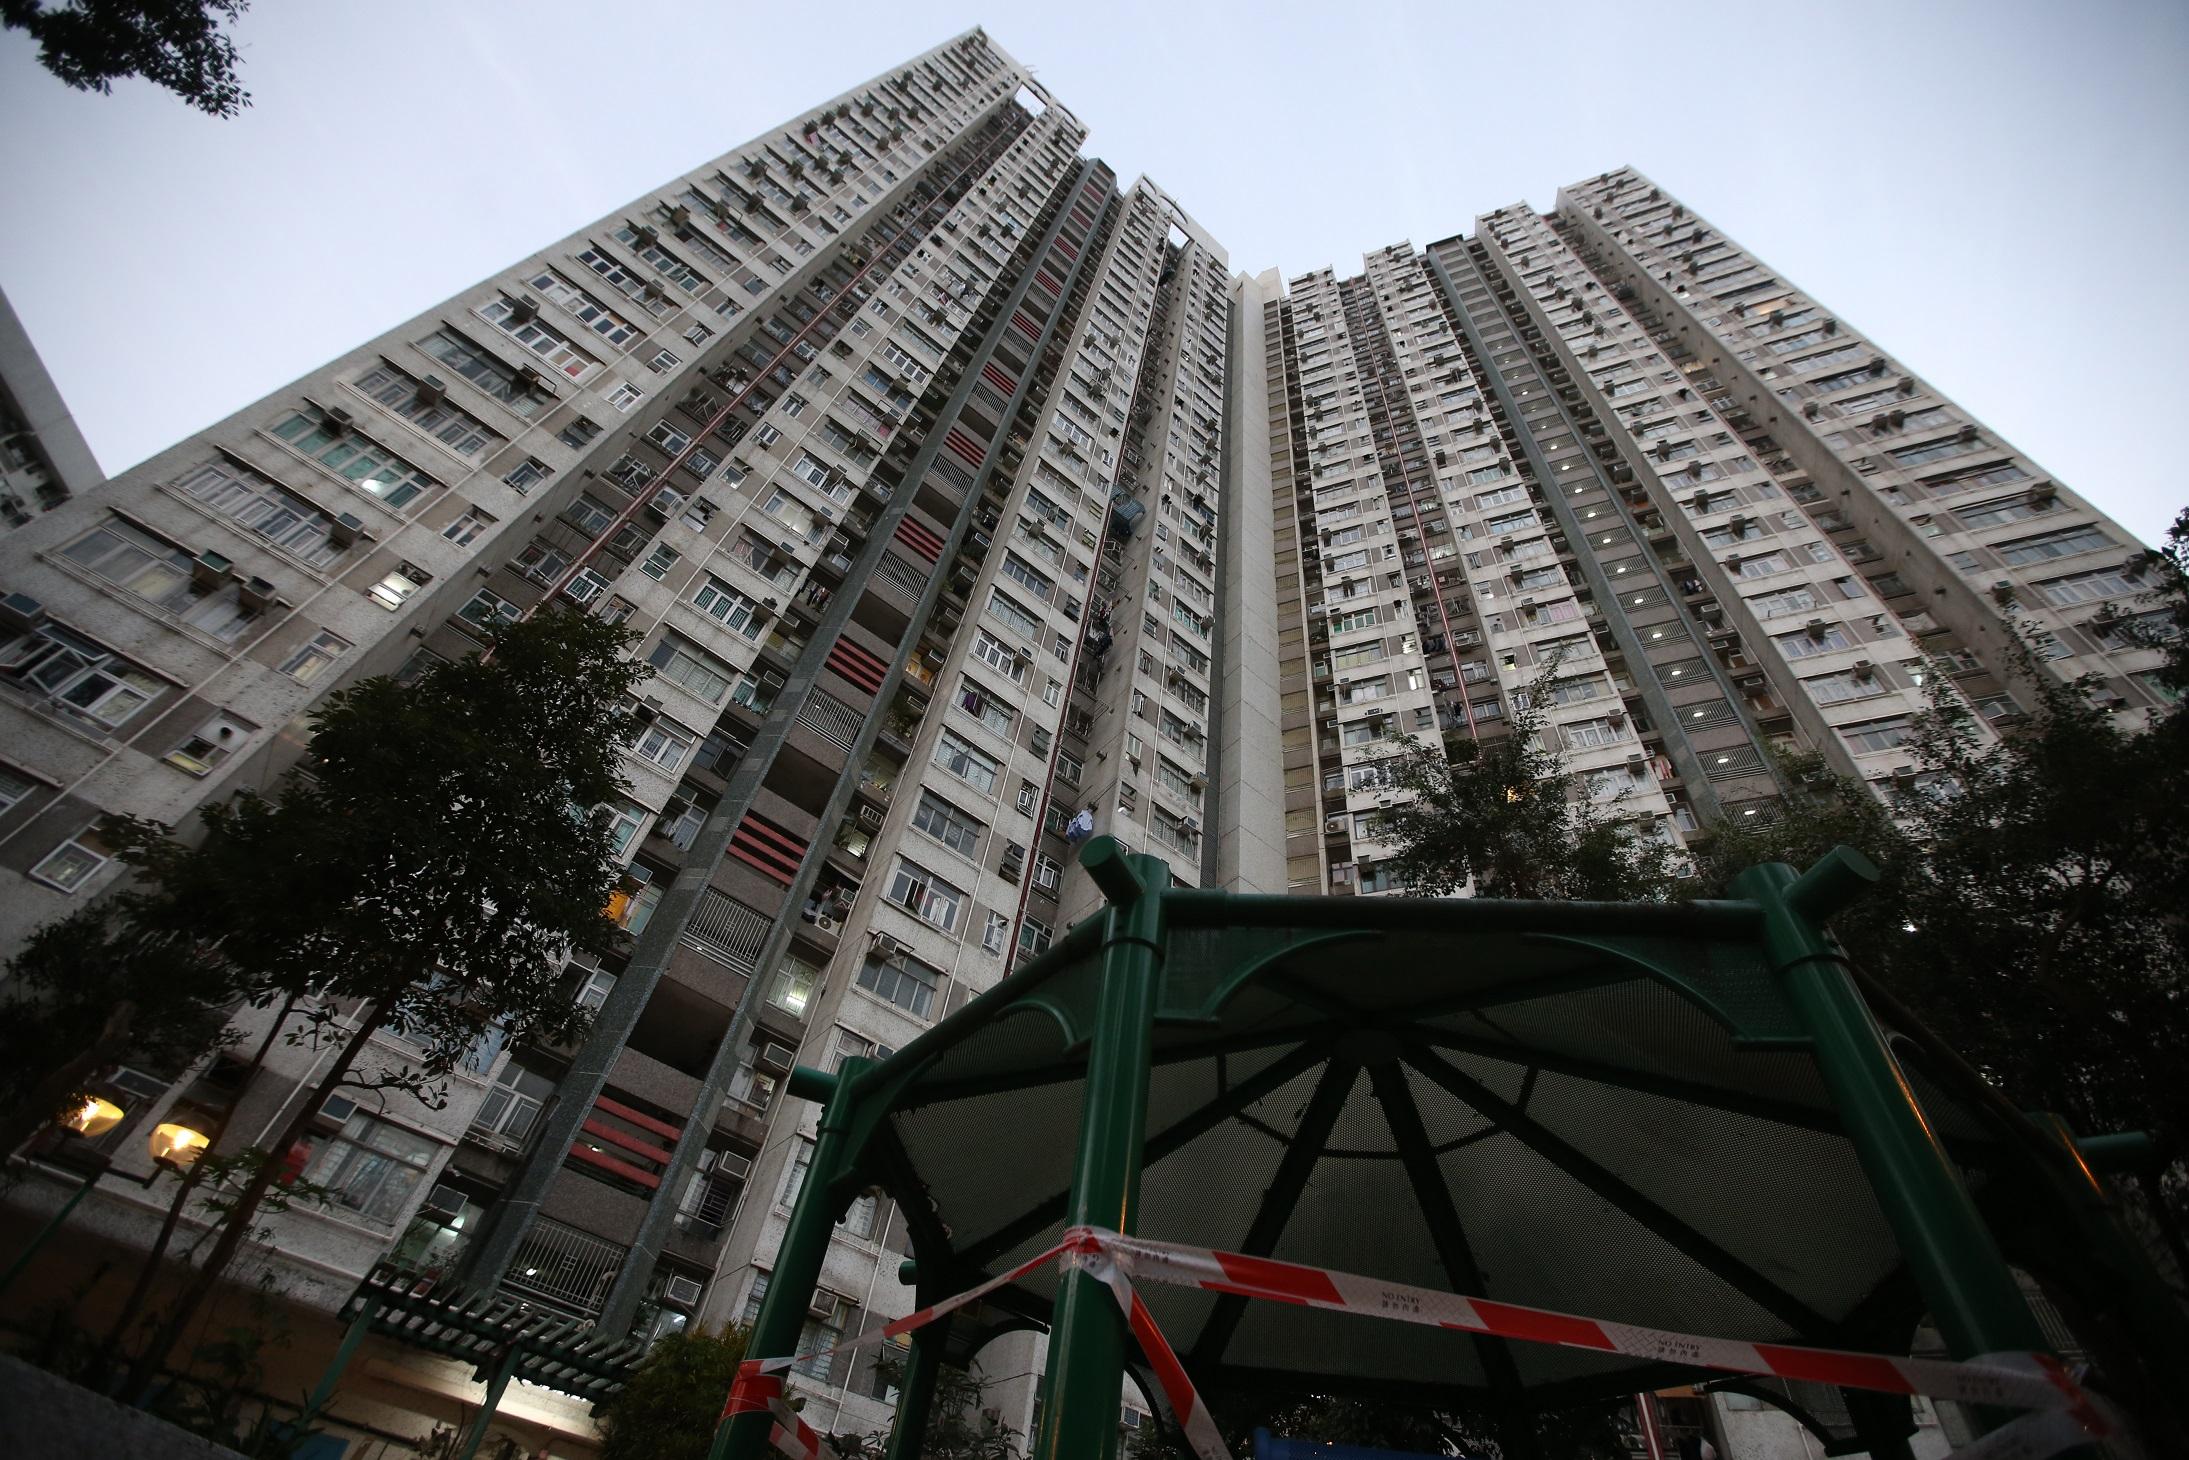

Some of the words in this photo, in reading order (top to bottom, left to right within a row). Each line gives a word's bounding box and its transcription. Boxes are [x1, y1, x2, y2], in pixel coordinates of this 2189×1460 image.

[1382, 1291, 1394, 1300] NO
[1396, 1295, 1421, 1304] ENTRY
[1658, 1339, 1672, 1347] NO
[1674, 1341, 1701, 1350] ENTRY
